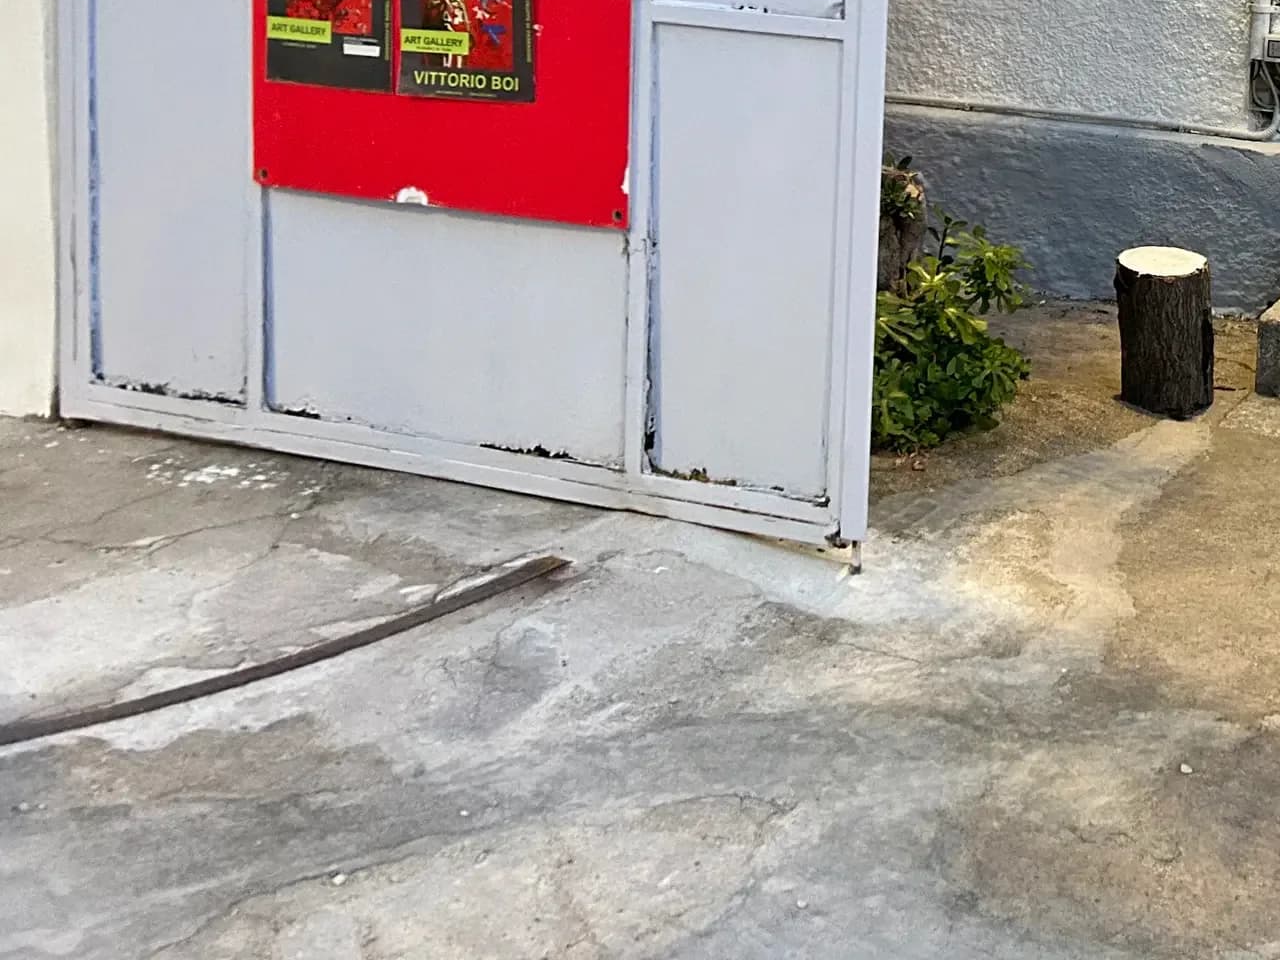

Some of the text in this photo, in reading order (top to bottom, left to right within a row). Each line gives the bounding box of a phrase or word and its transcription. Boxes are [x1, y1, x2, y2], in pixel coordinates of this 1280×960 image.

[271, 23, 326, 36] ART GALLERY
[404, 35, 463, 48] ART GALLERY
[413, 70, 520, 92] VITTORIO BOI
